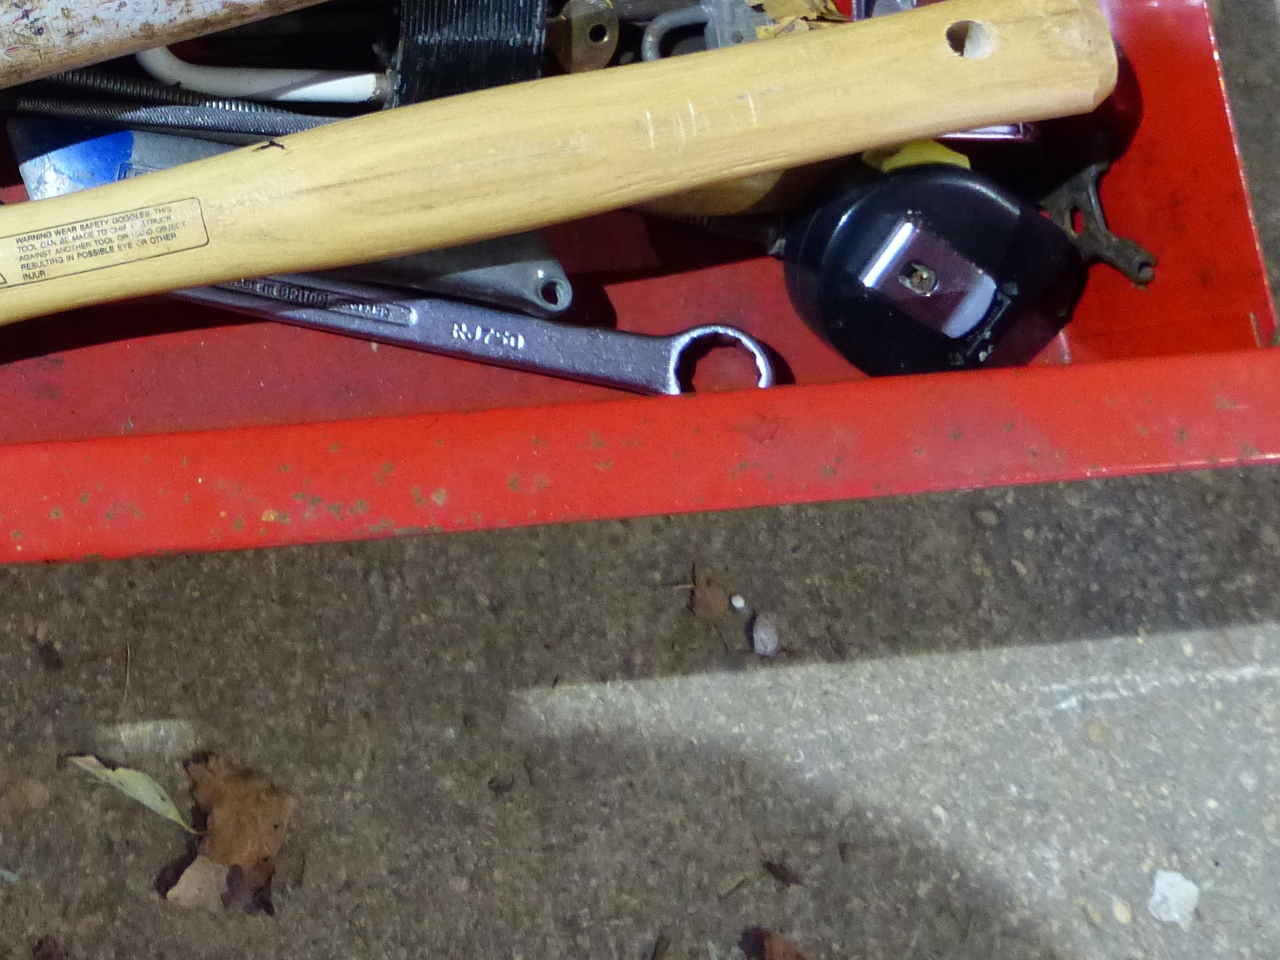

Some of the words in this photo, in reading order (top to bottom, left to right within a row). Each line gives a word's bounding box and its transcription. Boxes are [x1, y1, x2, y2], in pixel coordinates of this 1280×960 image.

[15, 231, 52, 245] WARNING
[54, 226, 77, 237] WEAR
[80, 219, 109, 232] SAFETY
[112, 210, 150, 225] GOGGLES
[153, 206, 172, 216] THIS
[17, 244, 38, 254] TOOL
[40, 239, 57, 249] CAN
[60, 237, 70, 245] BE
[72, 231, 94, 242] MADE
[96, 228, 108, 237] TO
[19, 249, 51, 263] AGAINST
[55, 242, 92, 255] ANOTHER
[94, 237, 115, 247] TOOL
[117, 233, 129, 242] OR
[20, 256, 64, 271] RESULTING
[66, 254, 75, 262] IN
[77, 245, 115, 260] POSSIBLE
[117, 242, 133, 252] EYE
[135, 239, 148, 247] OR
[149, 233, 177, 245] OTHER
[22, 270, 47, 282] INJUR
